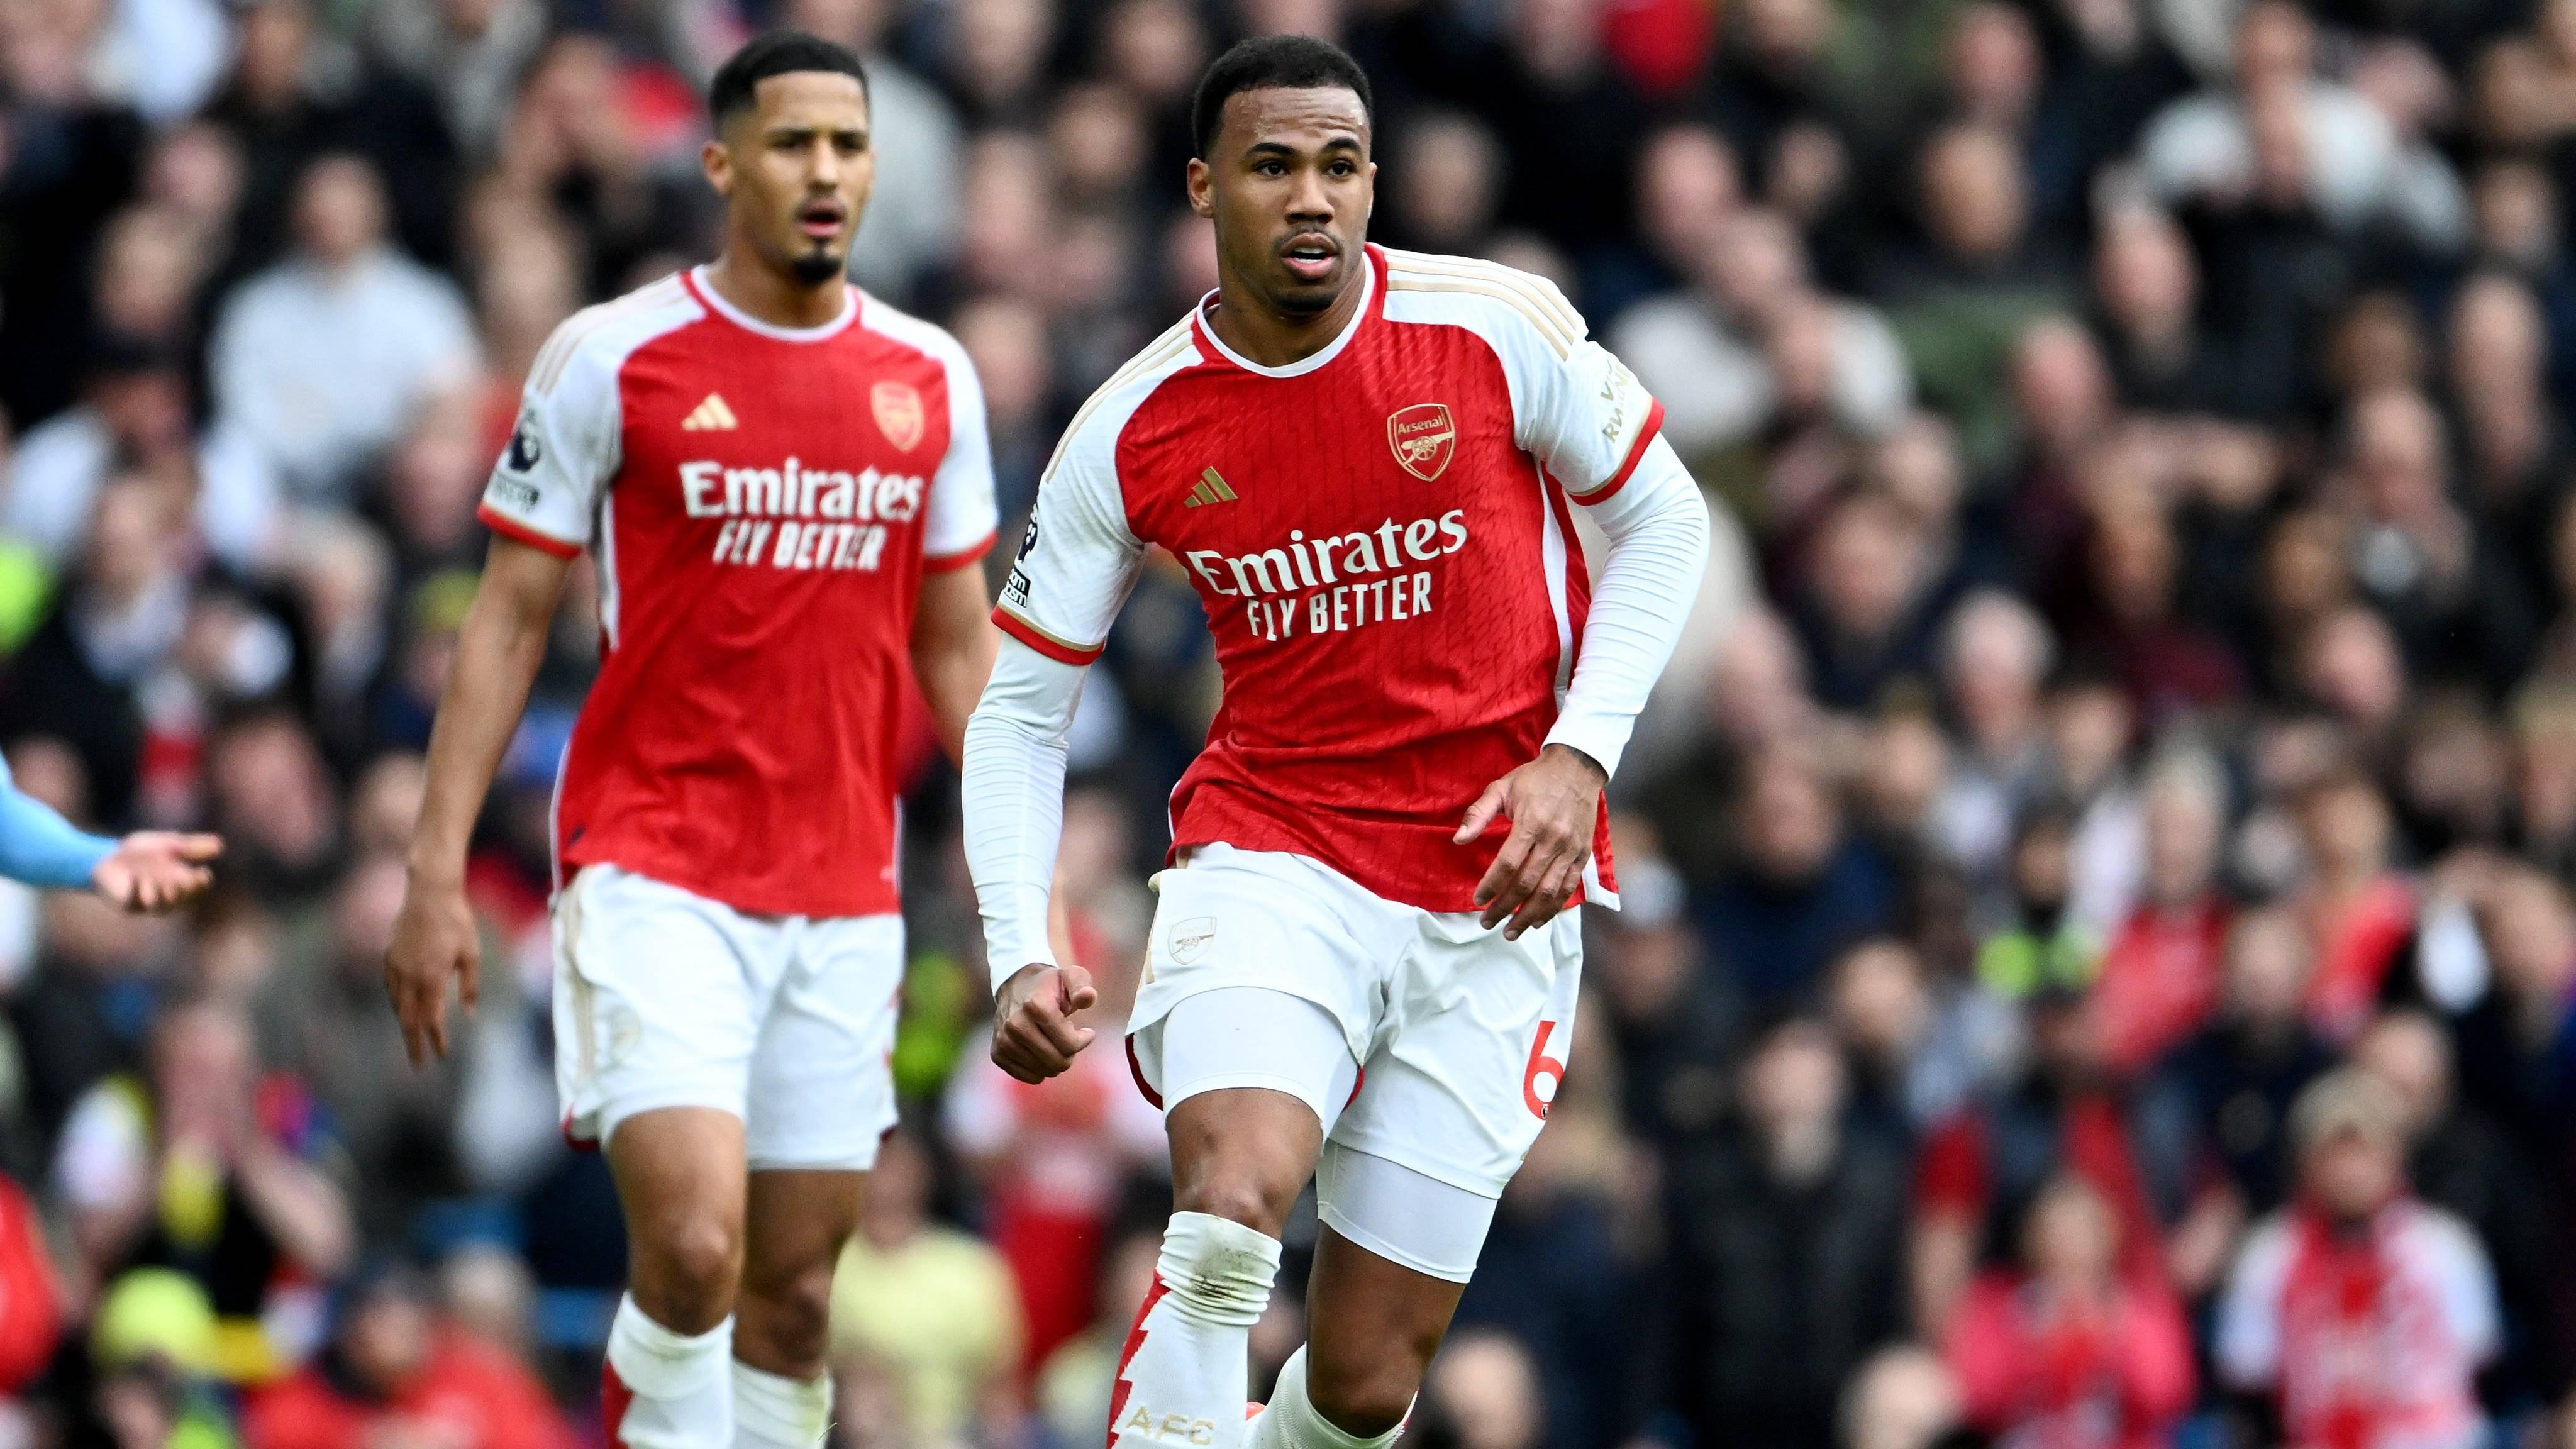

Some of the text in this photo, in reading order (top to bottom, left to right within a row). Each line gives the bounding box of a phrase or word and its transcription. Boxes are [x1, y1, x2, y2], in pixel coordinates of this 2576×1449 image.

[1397, 415, 1444, 435] Arsenal
[679, 456, 924, 523] Emirates
[713, 519, 887, 572] FLY BETTER
[1185, 508, 1468, 597] Emirates
[1246, 570, 1433, 641] FLY BETTER
[1523, 1019, 1565, 1122] 6
[1126, 1405, 1214, 1446] AFC
